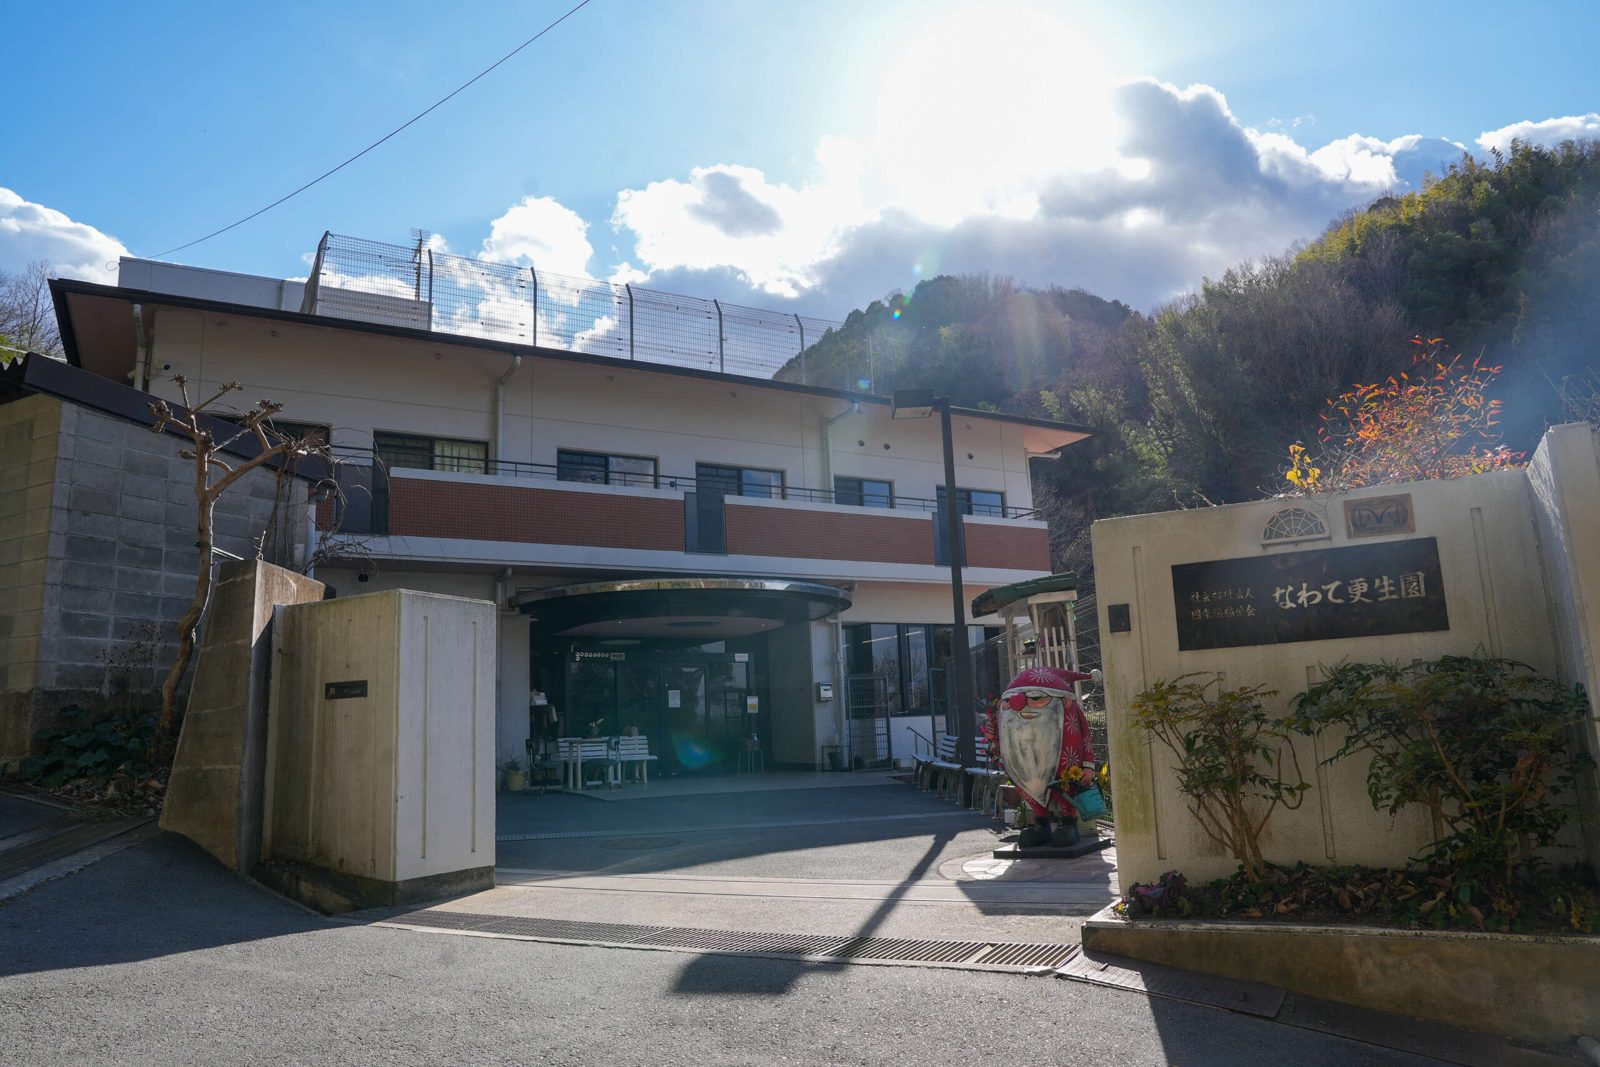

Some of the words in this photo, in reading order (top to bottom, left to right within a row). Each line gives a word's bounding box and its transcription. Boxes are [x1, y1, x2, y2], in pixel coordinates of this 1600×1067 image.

[1273, 571, 1426, 609] なわて更生園
